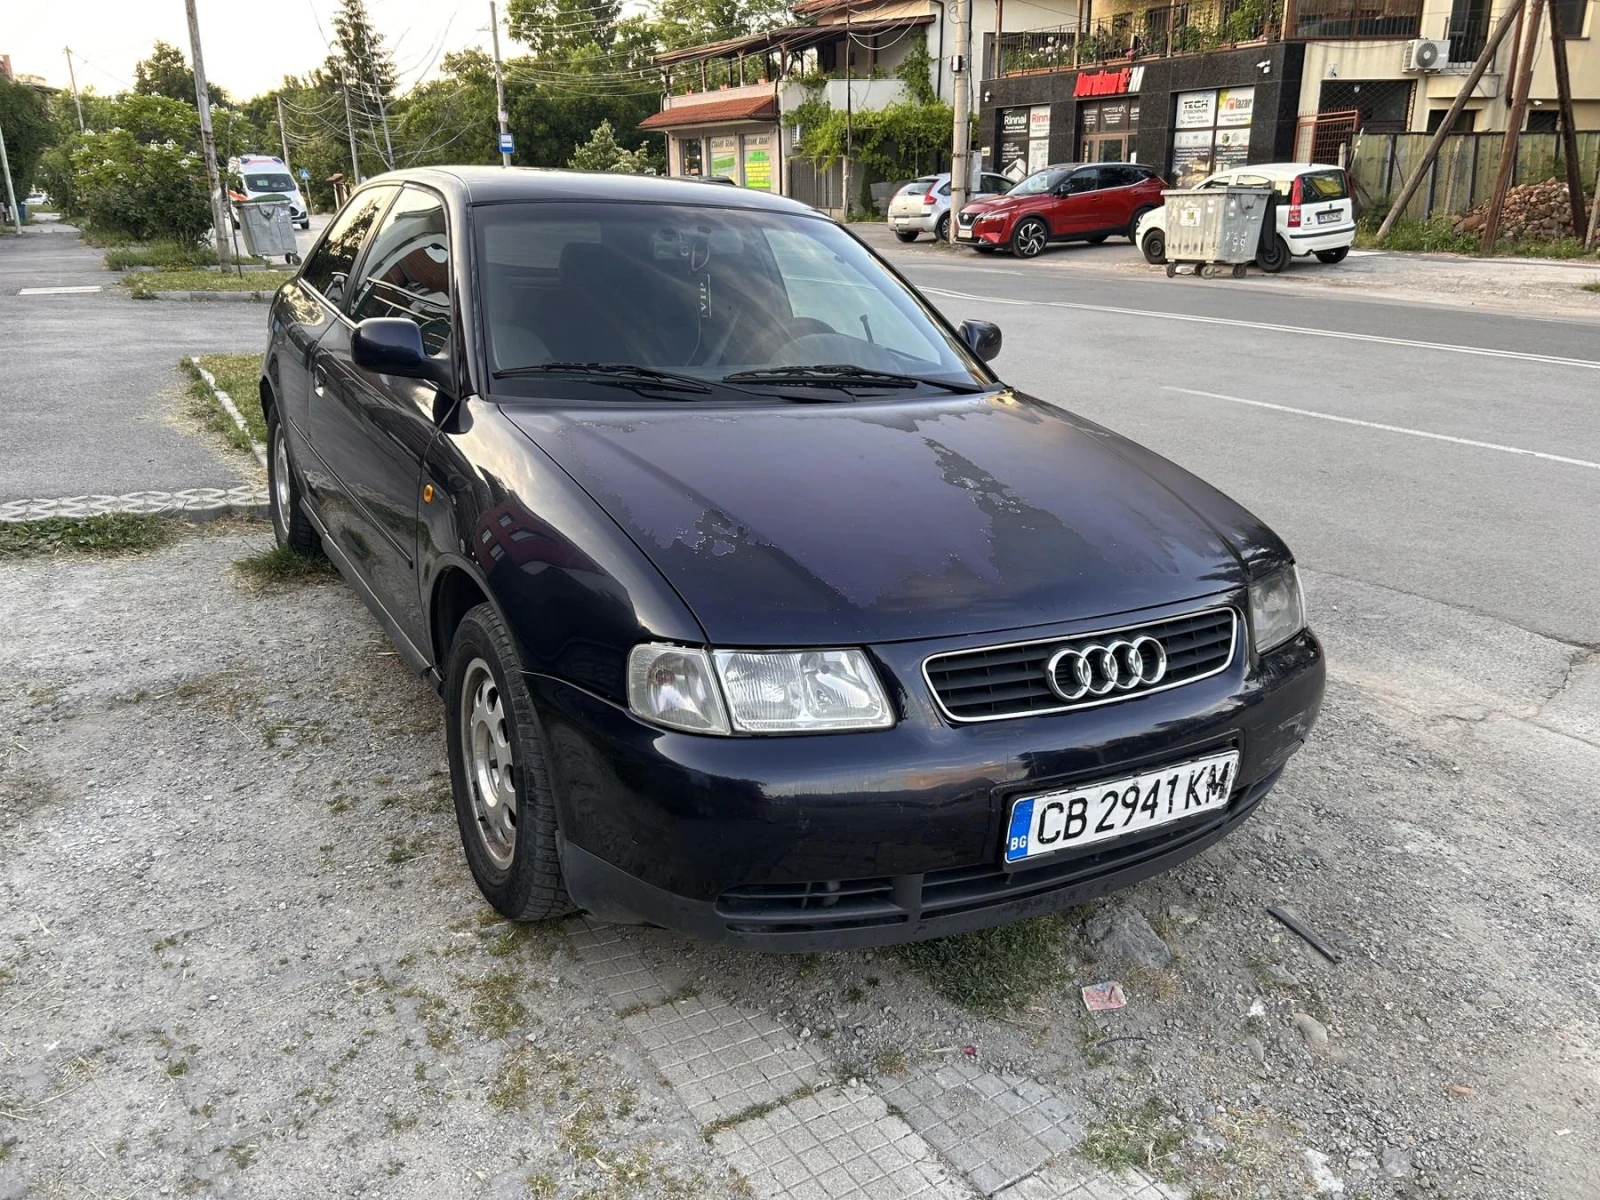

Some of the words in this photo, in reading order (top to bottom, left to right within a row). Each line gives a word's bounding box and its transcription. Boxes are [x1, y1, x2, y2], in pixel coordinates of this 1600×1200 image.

[1010, 835, 1027, 851] BG
[1094, 774, 1179, 834] 2941
[1184, 761, 1231, 810] KM
